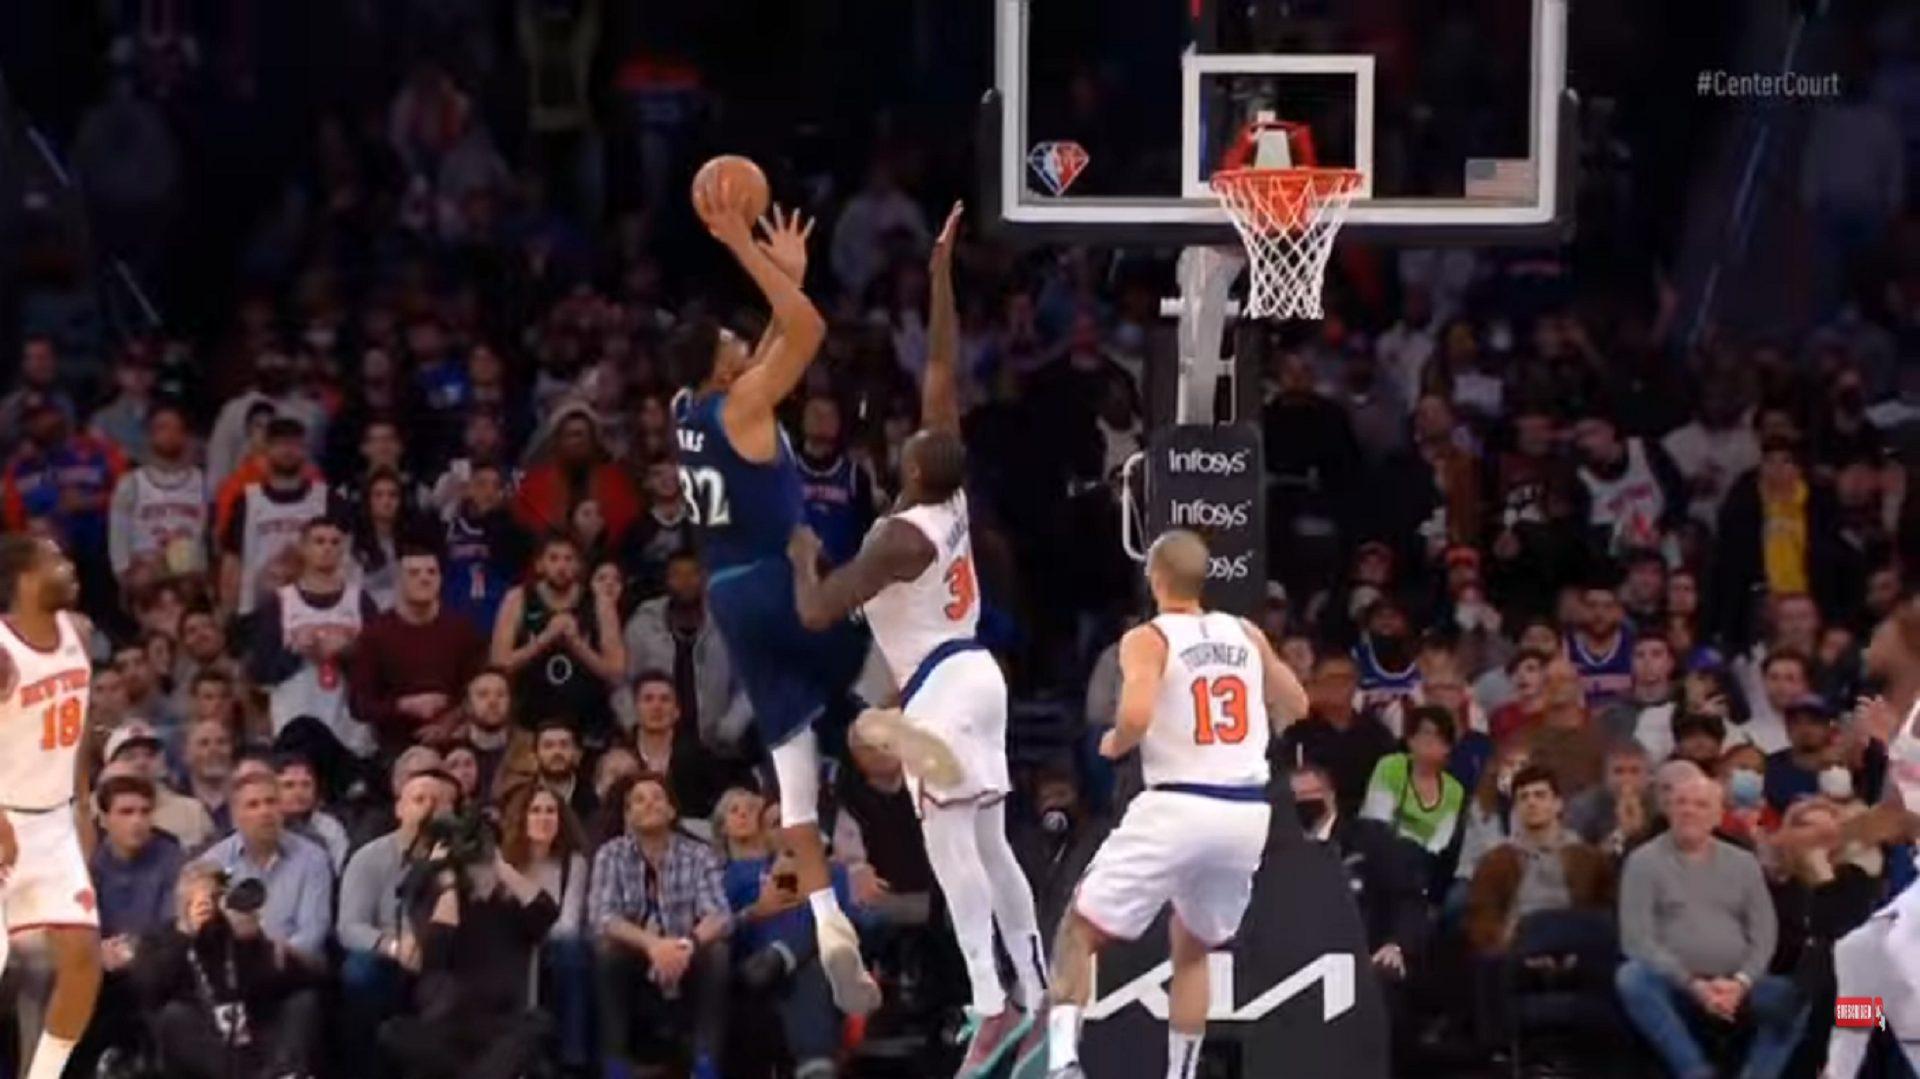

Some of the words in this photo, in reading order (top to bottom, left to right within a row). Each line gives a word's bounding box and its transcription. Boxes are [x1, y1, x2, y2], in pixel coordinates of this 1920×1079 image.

[1168, 448, 1246, 477] Infosys
[678, 466, 730, 526] 32
[1169, 499, 1248, 529] Infosys
[41, 697, 82, 751] 18
[1189, 674, 1249, 746] 13
